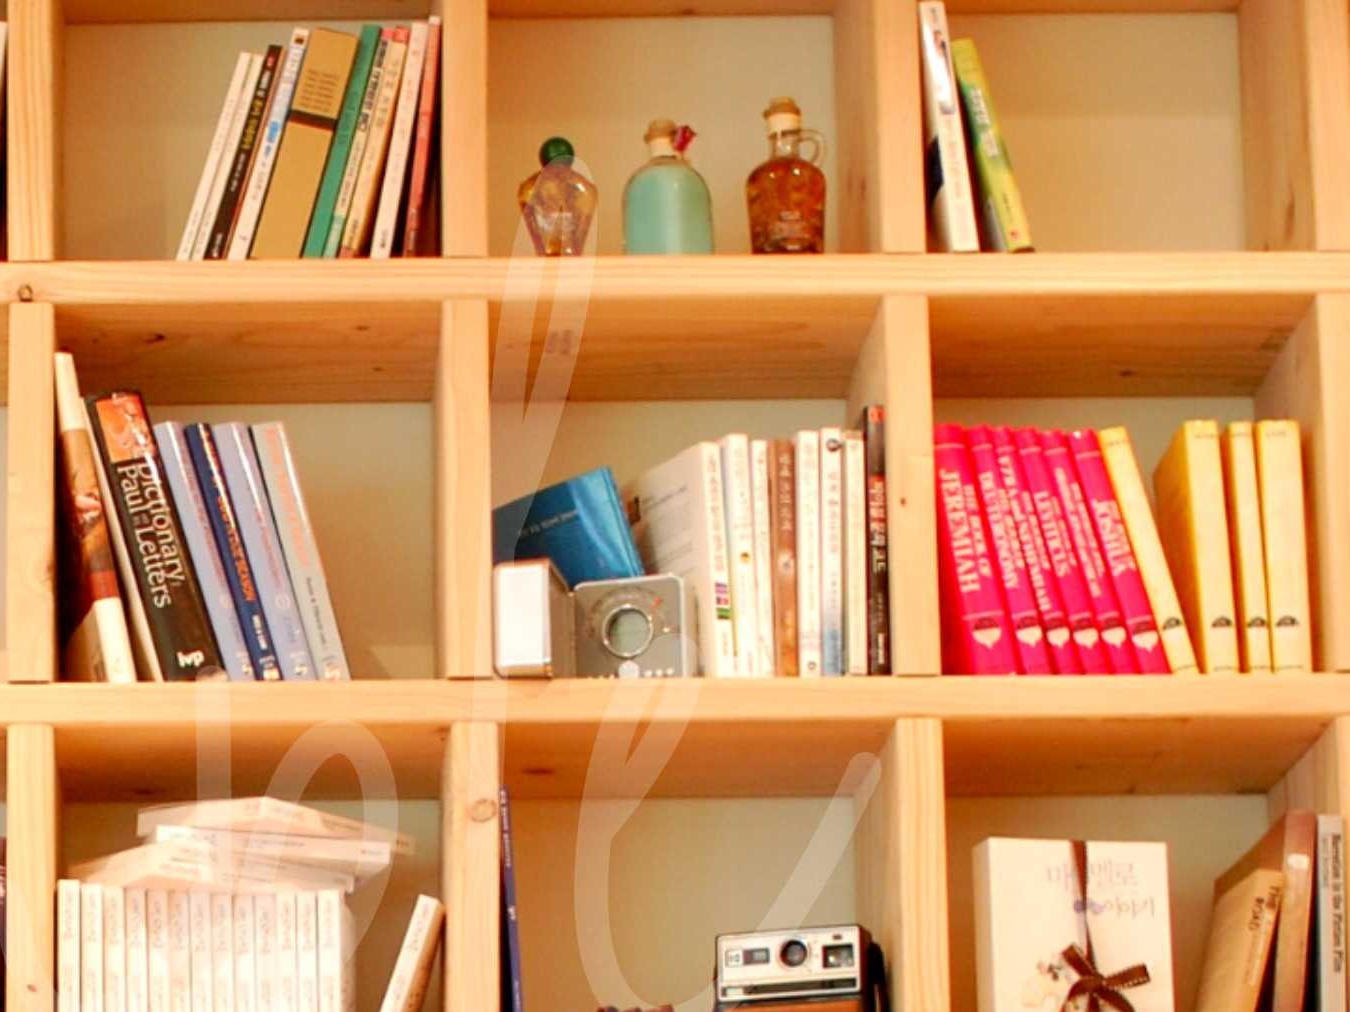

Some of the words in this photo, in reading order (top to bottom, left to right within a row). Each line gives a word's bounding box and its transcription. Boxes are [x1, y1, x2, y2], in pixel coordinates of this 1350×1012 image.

[117, 465, 148, 514] Paul
[136, 526, 171, 608] Letters
[941, 468, 980, 593] JEREMIAH
[980, 471, 1015, 589] DEUTERONOMY
[1036, 490, 1069, 577] LEVITICUS
[1092, 499, 1127, 577] JOSHUA
[1047, 859, 1138, 891] 마멜로
[1250, 898, 1264, 930] ROAD
[1266, 886, 1279, 910] THE
